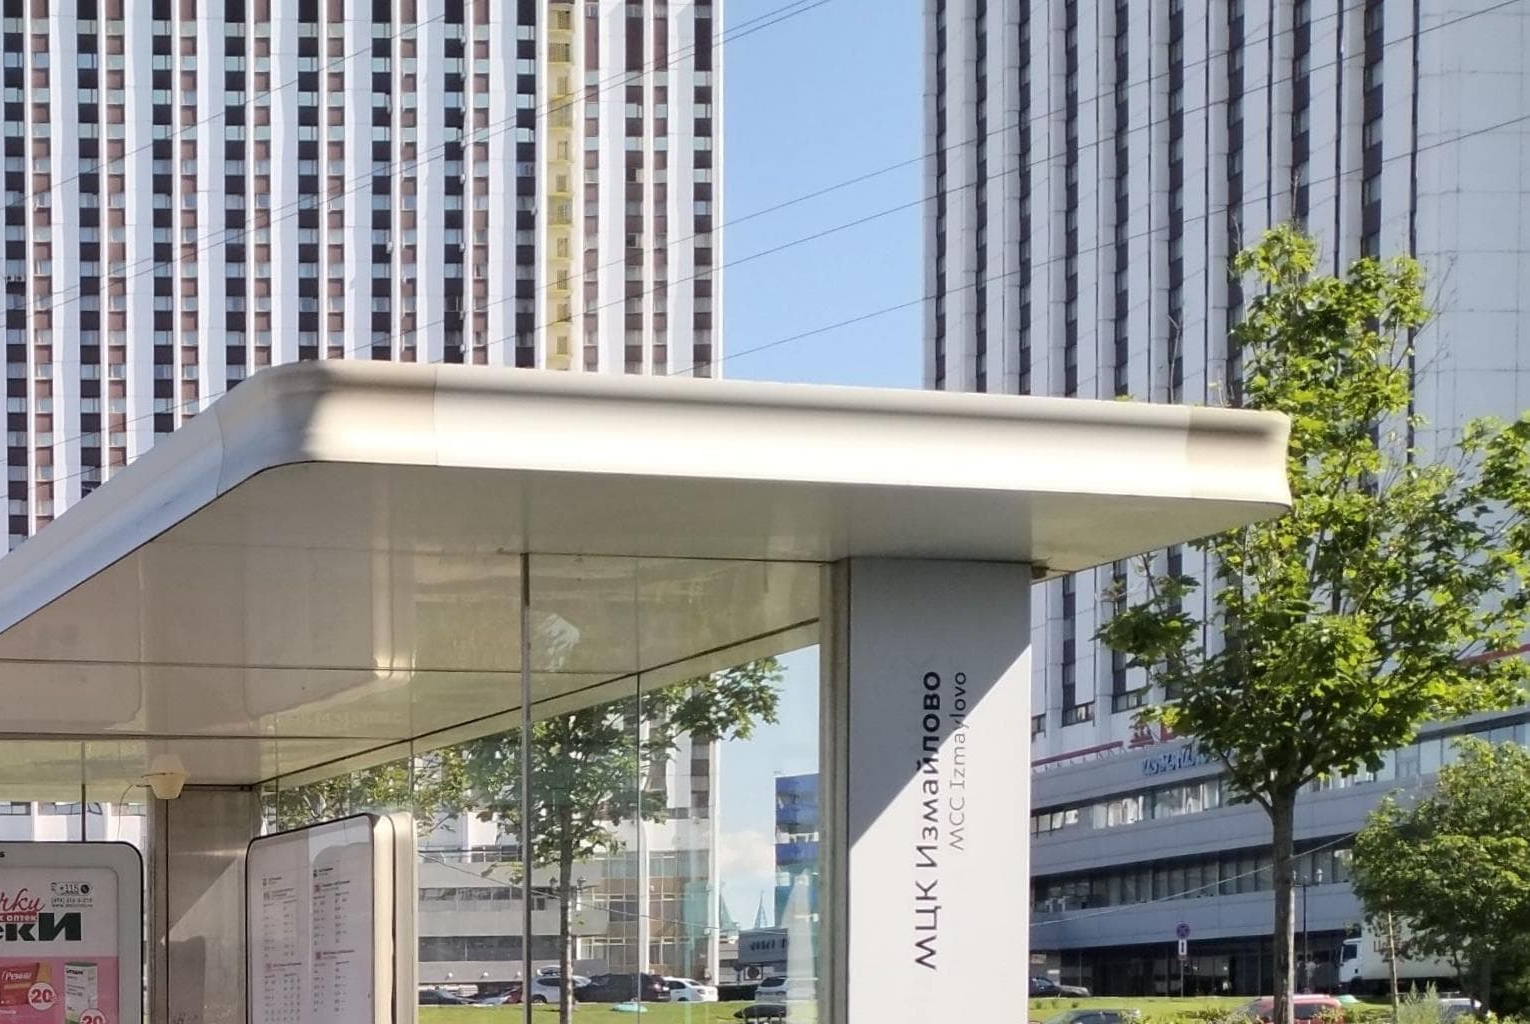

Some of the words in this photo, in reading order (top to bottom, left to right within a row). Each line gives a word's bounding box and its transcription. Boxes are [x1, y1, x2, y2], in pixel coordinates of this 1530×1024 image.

[916, 671, 941, 867] Измайлово
[949, 671, 969, 789] Izmaylovo
[949, 797, 965, 851] MCC
[915, 879, 942, 969] МЦК
